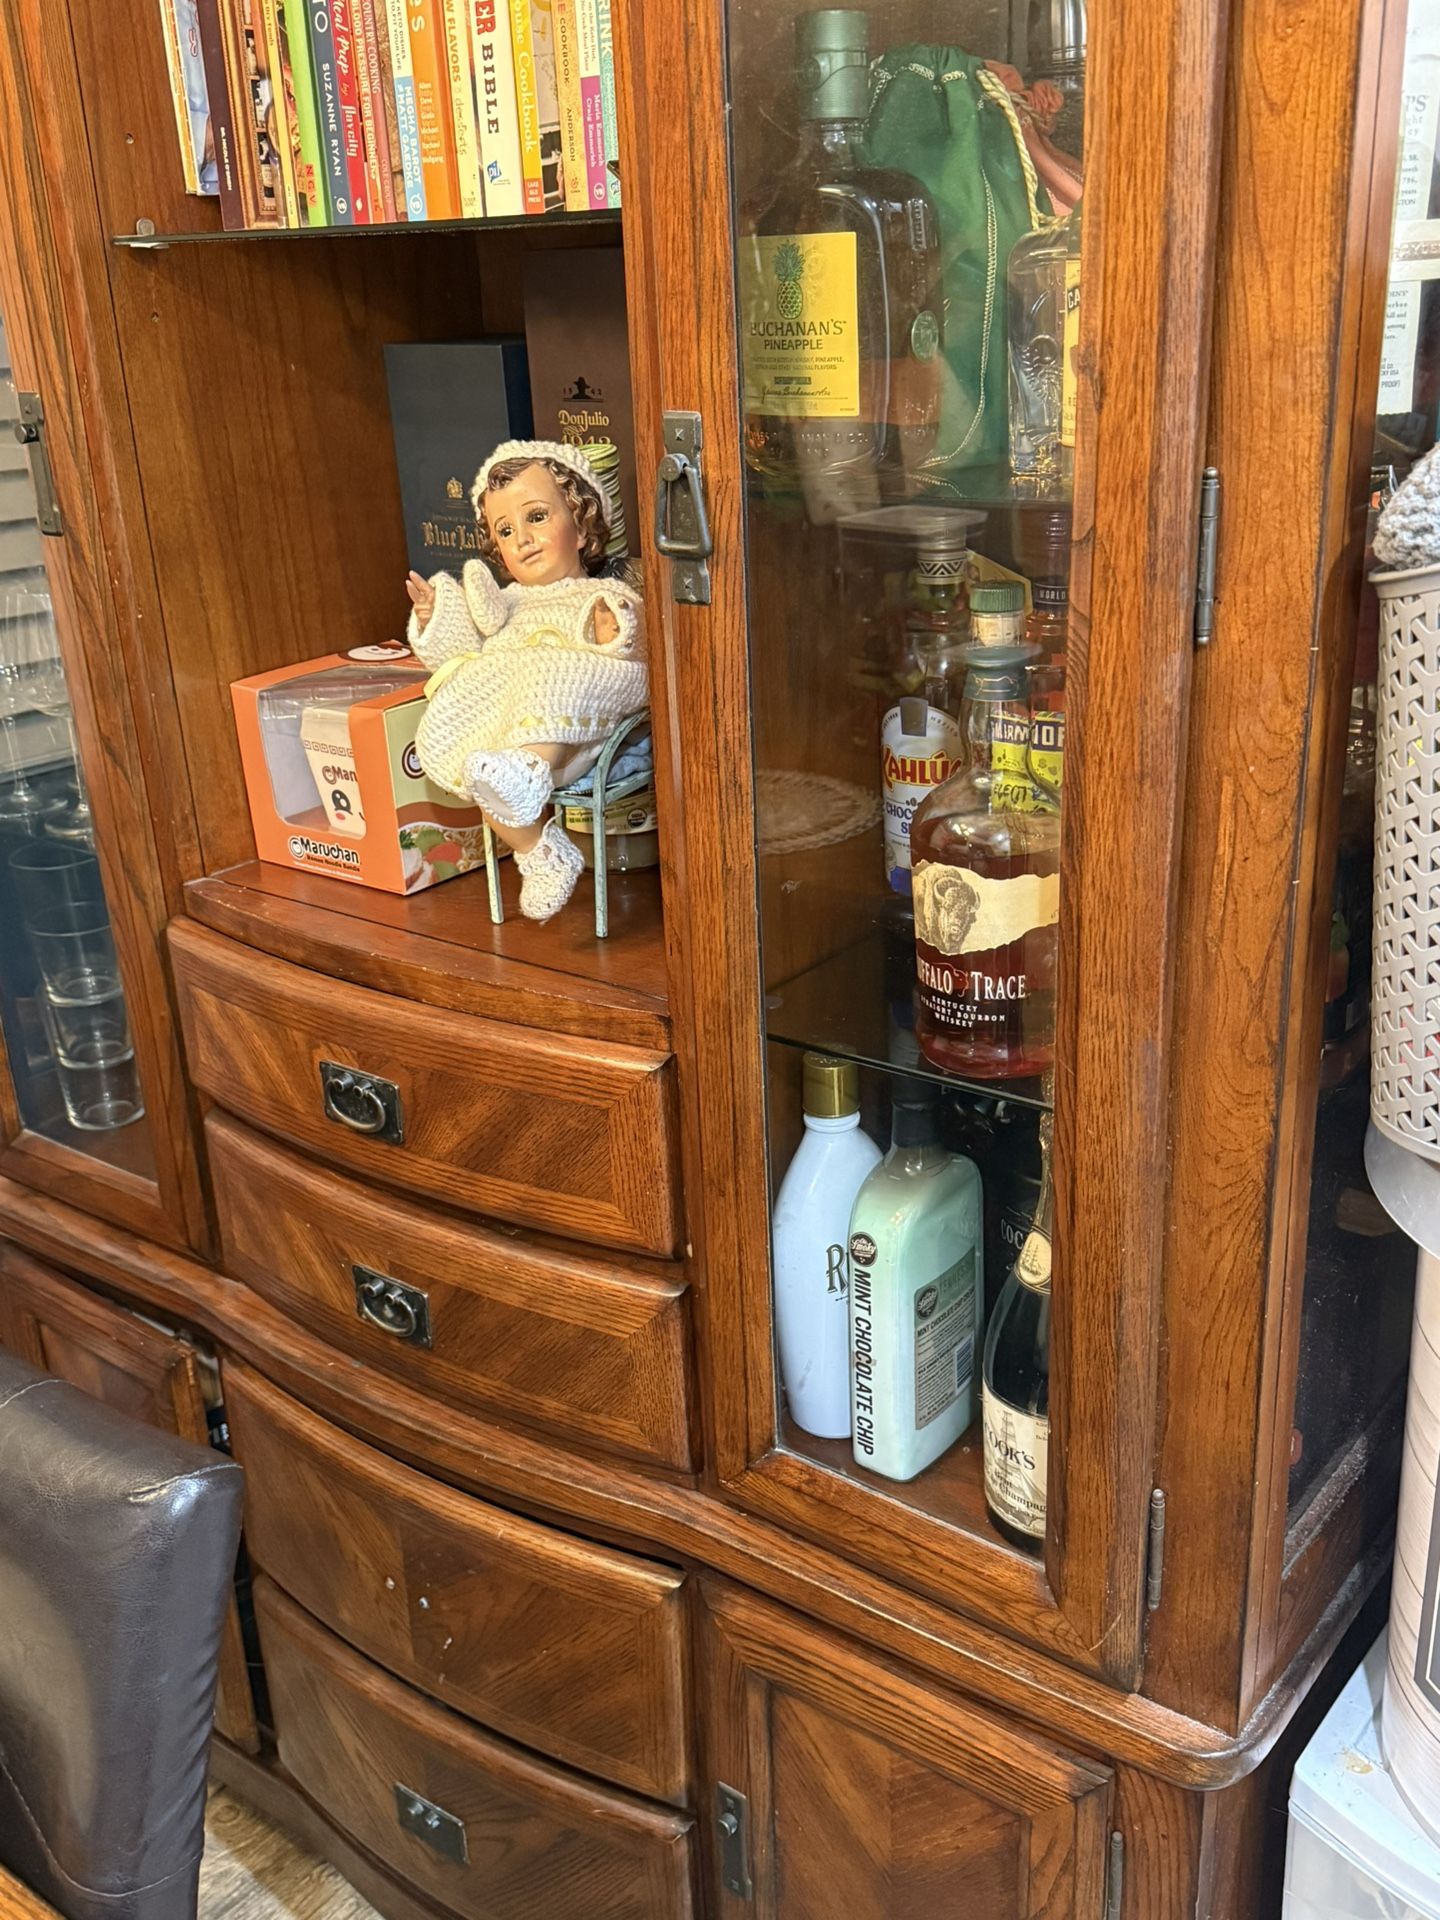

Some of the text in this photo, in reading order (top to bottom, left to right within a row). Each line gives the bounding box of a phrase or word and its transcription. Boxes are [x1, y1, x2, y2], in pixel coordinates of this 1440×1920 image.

[336, 35, 351, 76] Prep
[367, 47, 381, 94] COOKING
[447, 17, 461, 83] FLAVORS
[355, 38, 369, 94] PRESSURE
[362, 96, 373, 119] FOR
[481, 43, 499, 135] BIBLE
[559, 17, 570, 84] COOKBOOK
[566, 107, 576, 162] ANDERSON
[322, 63, 338, 132] SUZANNE
[330, 139, 342, 176] RYAN
[519, 51, 537, 153] Cookbook
[341, 104, 361, 157] flavcity
[404, 86, 421, 184] MEGHA BAROT
[588, 124, 597, 168] Emmerich
[595, 123, 605, 167] Emmerich
[401, 134, 413, 190] GAEDKE
[750, 318, 844, 337] BUCHANAN'S
[764, 339, 824, 350] PINEAPPLE
[885, 801, 912, 820] CHOC
[300, 837, 360, 864] Maruchan
[931, 995, 979, 1013] KENTUCKY
[970, 971, 1027, 1002] TRACE
[934, 1012, 974, 1028] WHISKEY
[956, 1011, 1006, 1022] BOURBON
[854, 1268, 872, 1316] MINT
[855, 1316, 873, 1415] CHOCOLATE
[856, 1415, 874, 1456] CHIP
